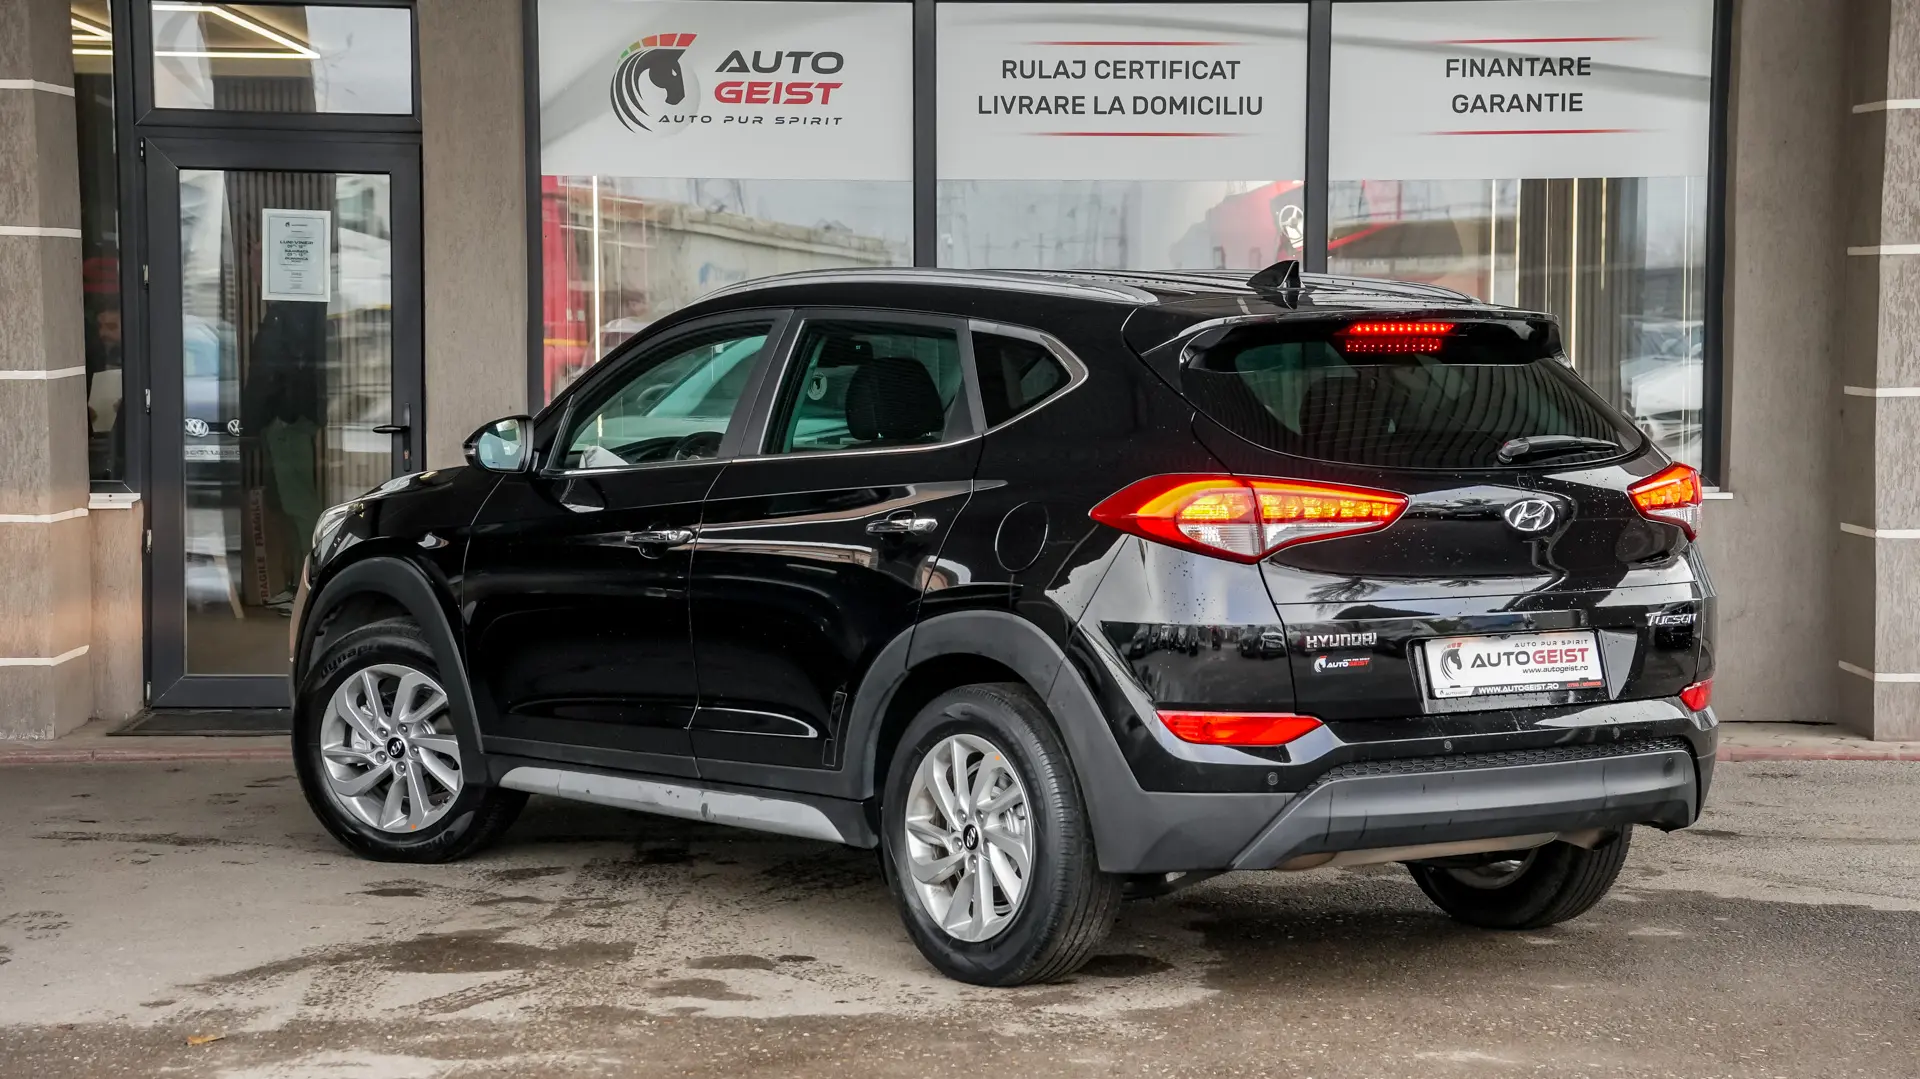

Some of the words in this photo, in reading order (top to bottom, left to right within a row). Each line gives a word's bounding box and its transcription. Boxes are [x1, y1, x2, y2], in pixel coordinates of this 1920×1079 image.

[714, 49, 844, 75] AUTO
[1001, 59, 1087, 80] RULAJ
[1094, 59, 1241, 80] CERTIFICAT
[1445, 57, 1592, 78] FINANTARE
[713, 80, 844, 105] GEIST
[1451, 92, 1584, 114] GARANTIE
[977, 95, 1086, 115] LIVRARE
[1093, 95, 1126, 115] LA
[1132, 95, 1263, 116] DOMICILIU
[658, 114, 713, 124] AUTO
[723, 115, 764, 125] PUR
[774, 116, 843, 126] SPIRIT
[1306, 632, 1377, 649] HYUNDAI
[1470, 648, 1590, 669] AUTOGEIST
[1522, 664, 1589, 674] www.autogeist.ro
[1478, 682, 1560, 695] WWW.AUTOGEIST.RO
